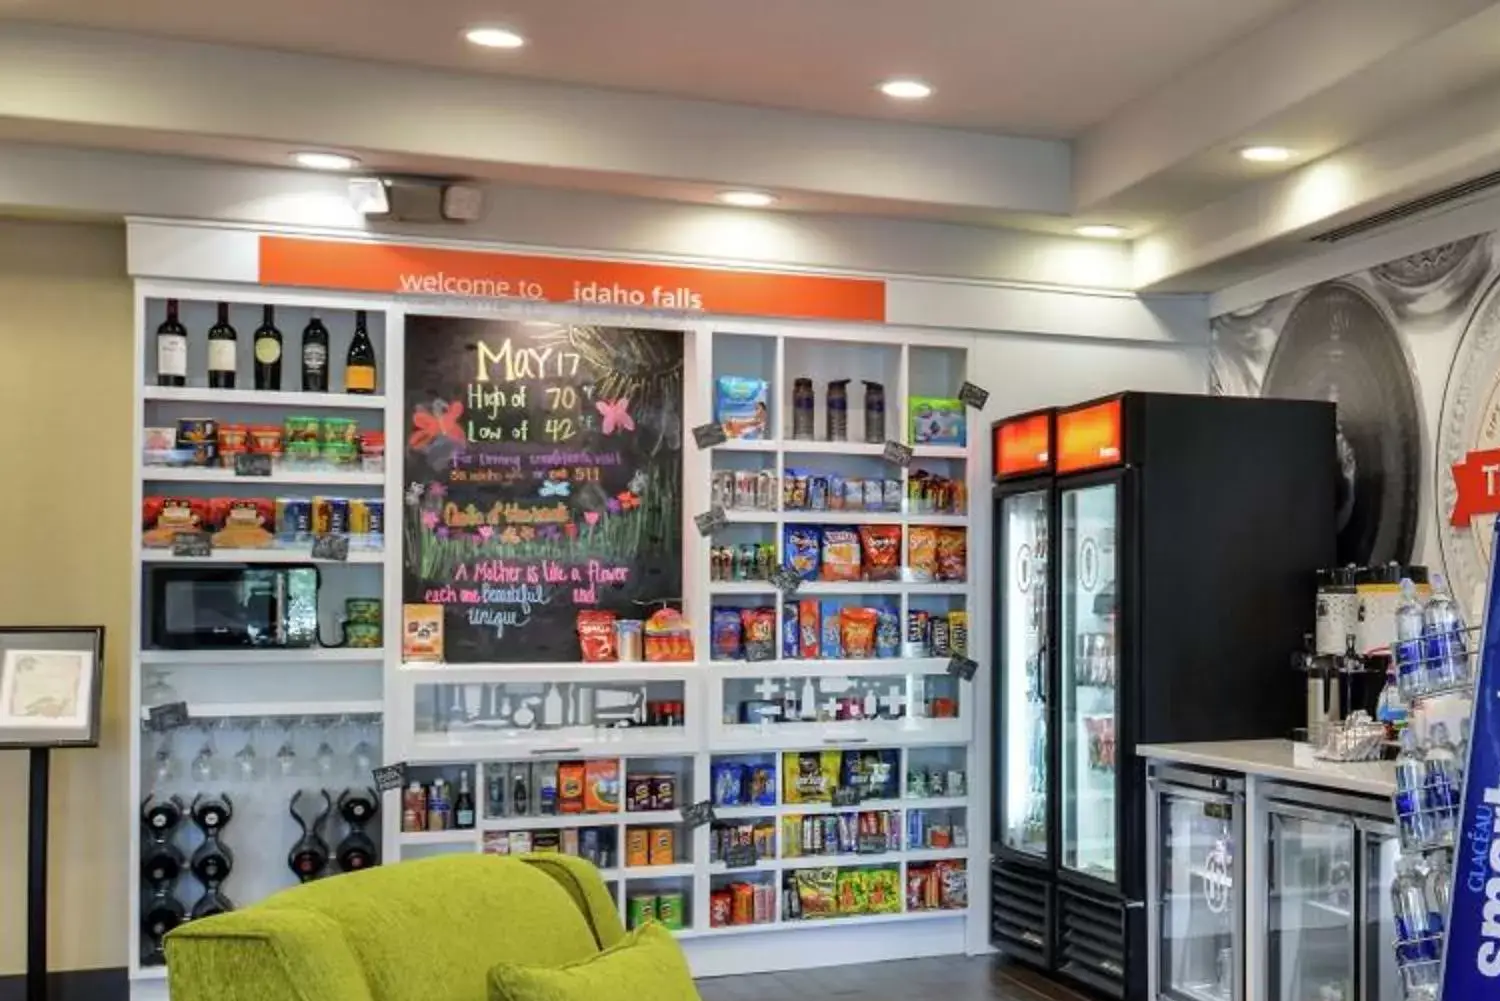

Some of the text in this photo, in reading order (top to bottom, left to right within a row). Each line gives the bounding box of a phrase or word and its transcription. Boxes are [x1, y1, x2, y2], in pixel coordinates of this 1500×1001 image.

[400, 271, 544, 300] welcome to
[572, 279, 704, 310] idaho falls
[556, 352, 580, 378] 17
[467, 384, 507, 421] High
[511, 385, 526, 409] of
[545, 387, 577, 410] 70
[467, 420, 501, 443] Low
[511, 420, 529, 441] of
[544, 418, 576, 441] 42
[574, 467, 601, 481] 511
[455, 563, 469, 582] A
[473, 560, 523, 583] Mother
[526, 563, 539, 584] is
[542, 559, 568, 583] like
[570, 567, 581, 582] a
[1466, 804, 1493, 893] GLACÉAU
